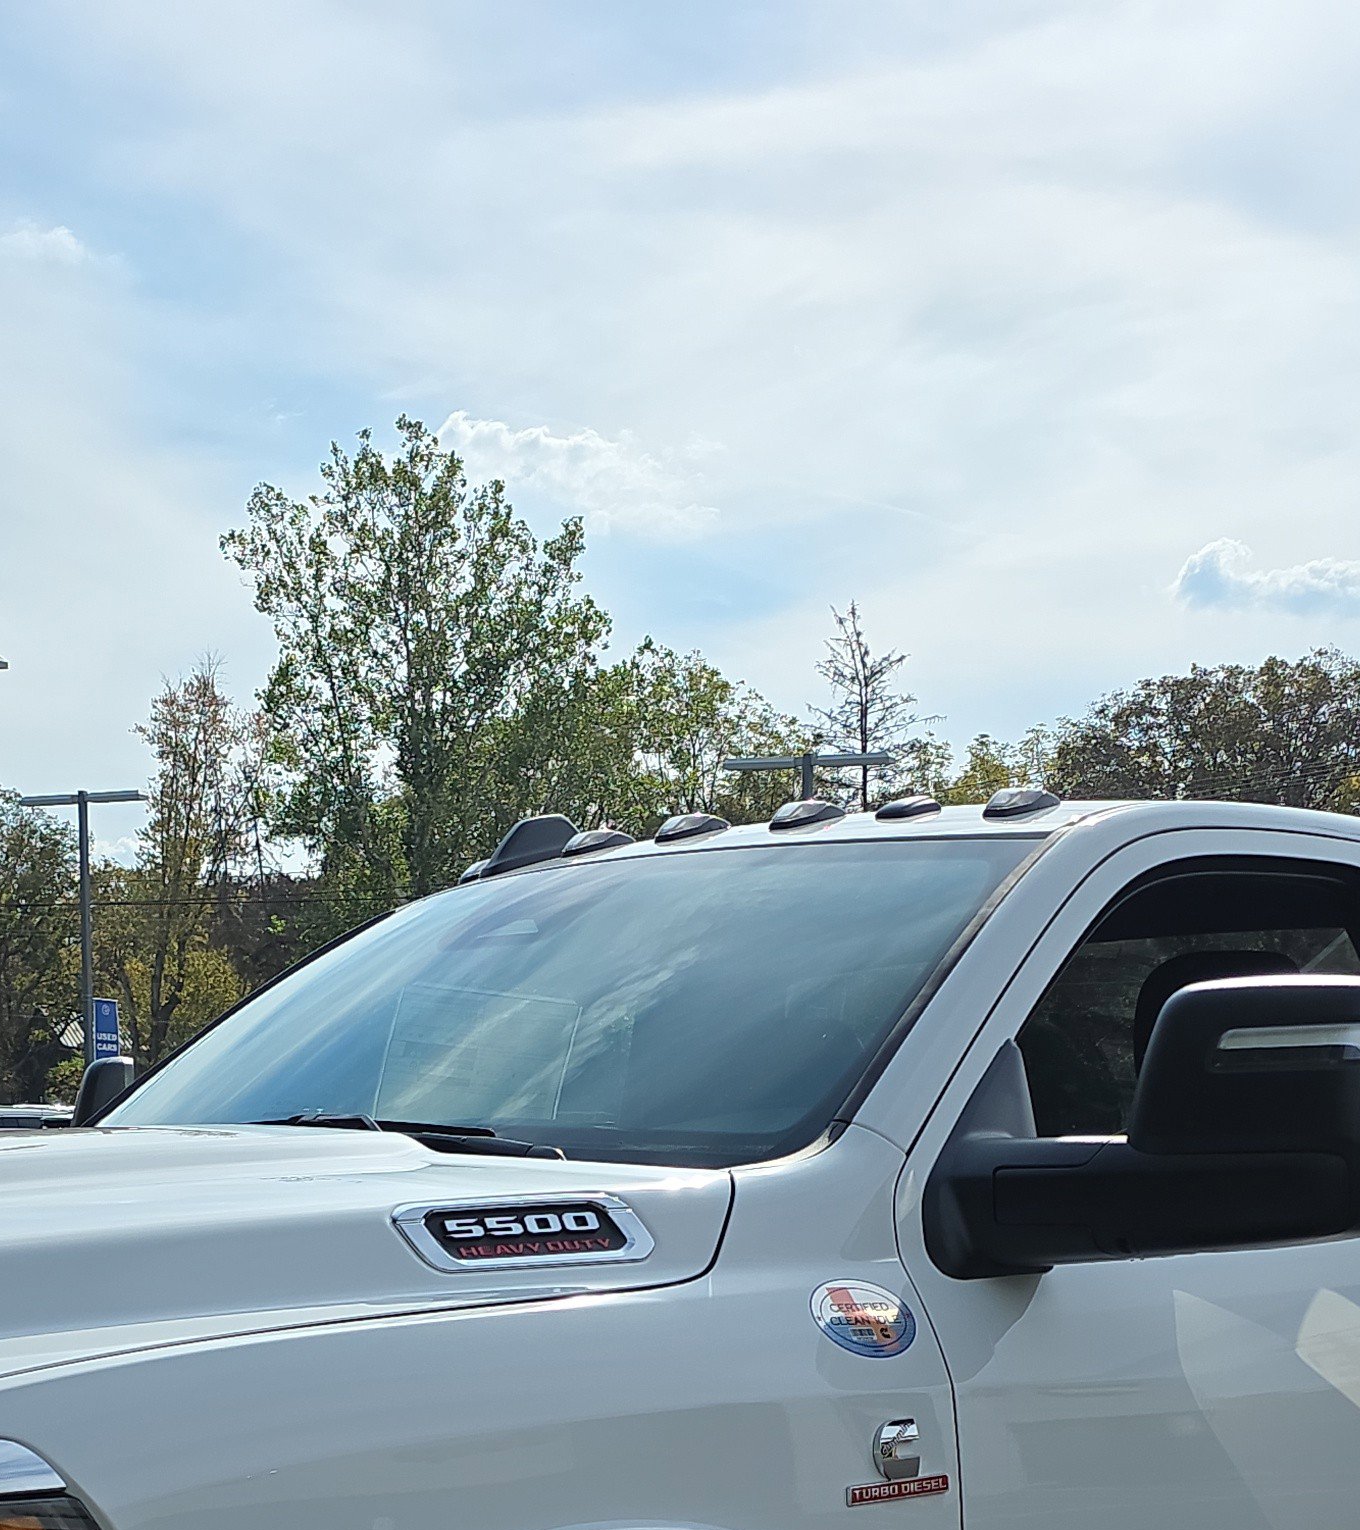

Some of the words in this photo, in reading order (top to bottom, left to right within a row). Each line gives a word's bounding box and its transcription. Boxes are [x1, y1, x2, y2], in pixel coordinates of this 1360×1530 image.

[96, 1032, 118, 1041] USED
[96, 1042, 118, 1052] CARS
[442, 1210, 600, 1240] 5500
[459, 1241, 542, 1260] HEAVY
[547, 1237, 611, 1255] DUTY
[829, 1302, 890, 1313] CERTIFIED
[830, 1315, 871, 1326] CLEAN
[852, 1484, 899, 1500] TURBO
[901, 1476, 948, 1495] DIESEL
